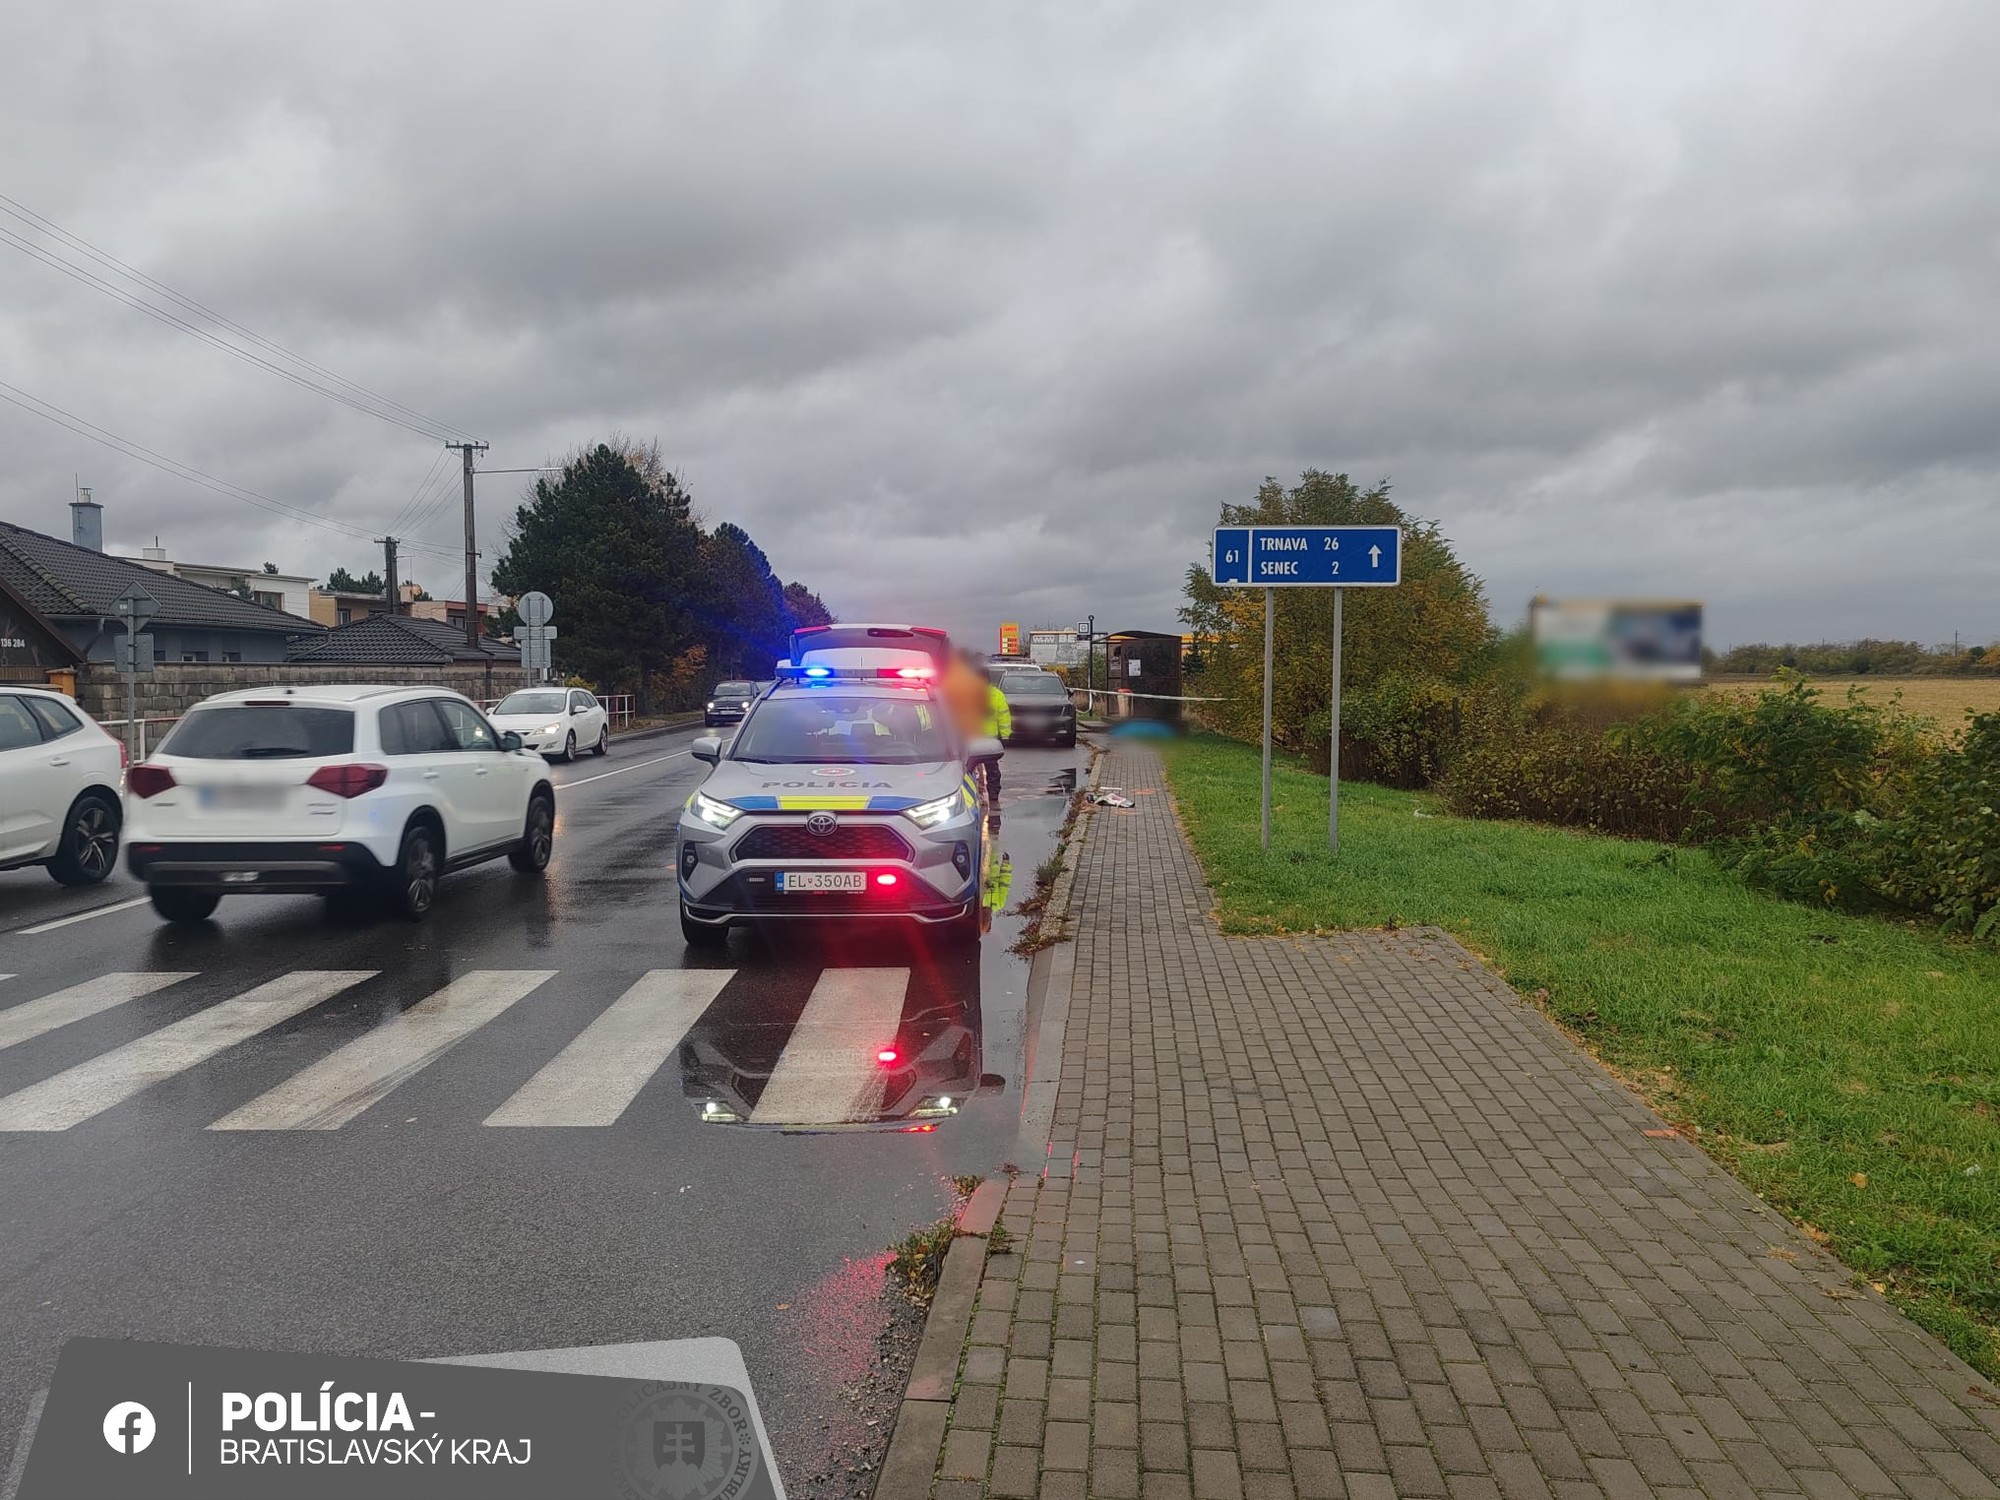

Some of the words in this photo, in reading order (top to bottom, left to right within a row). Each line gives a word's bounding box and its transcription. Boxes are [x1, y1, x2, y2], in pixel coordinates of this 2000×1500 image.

[1259, 537, 1308, 551] TRNAVA
[1323, 537, 1340, 551] 26
[1225, 550, 1240, 563] 61
[1260, 561, 1299, 575] SENEC
[1331, 561, 1340, 575] 2
[788, 874, 806, 888] EL
[814, 874, 862, 888] 350AB
